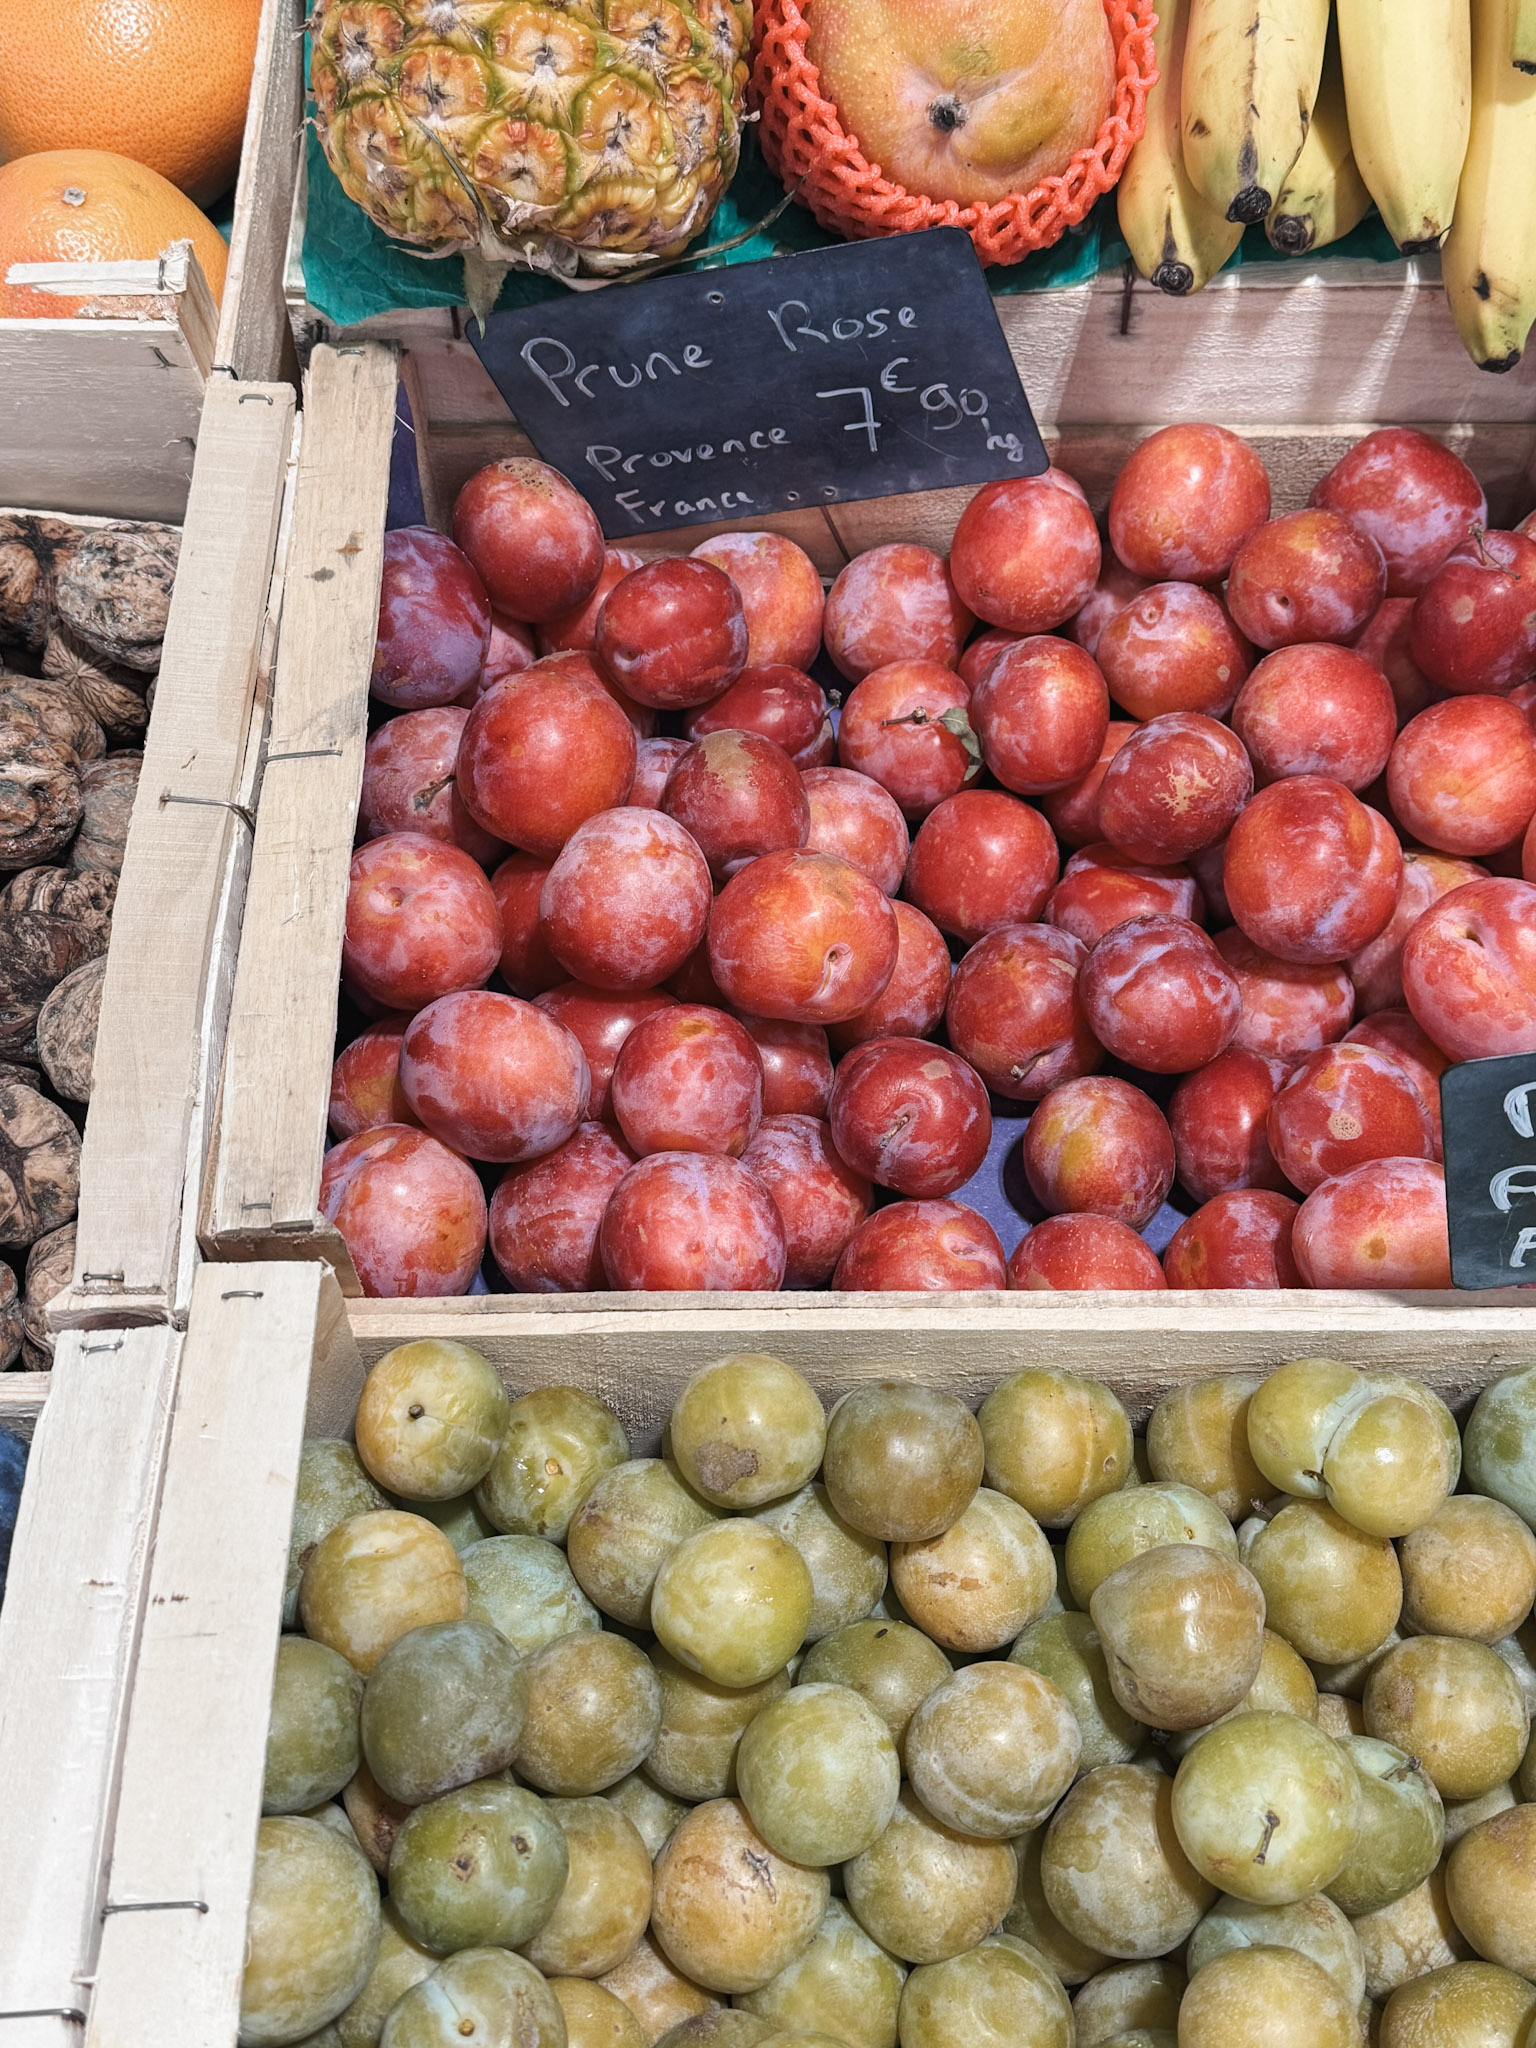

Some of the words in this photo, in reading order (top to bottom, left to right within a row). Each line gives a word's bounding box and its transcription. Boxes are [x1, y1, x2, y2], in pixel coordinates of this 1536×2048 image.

[520, 336, 713, 407] Prune
[767, 300, 919, 352] Rose
[585, 427, 792, 482] Provence
[615, 488, 754, 524] France
